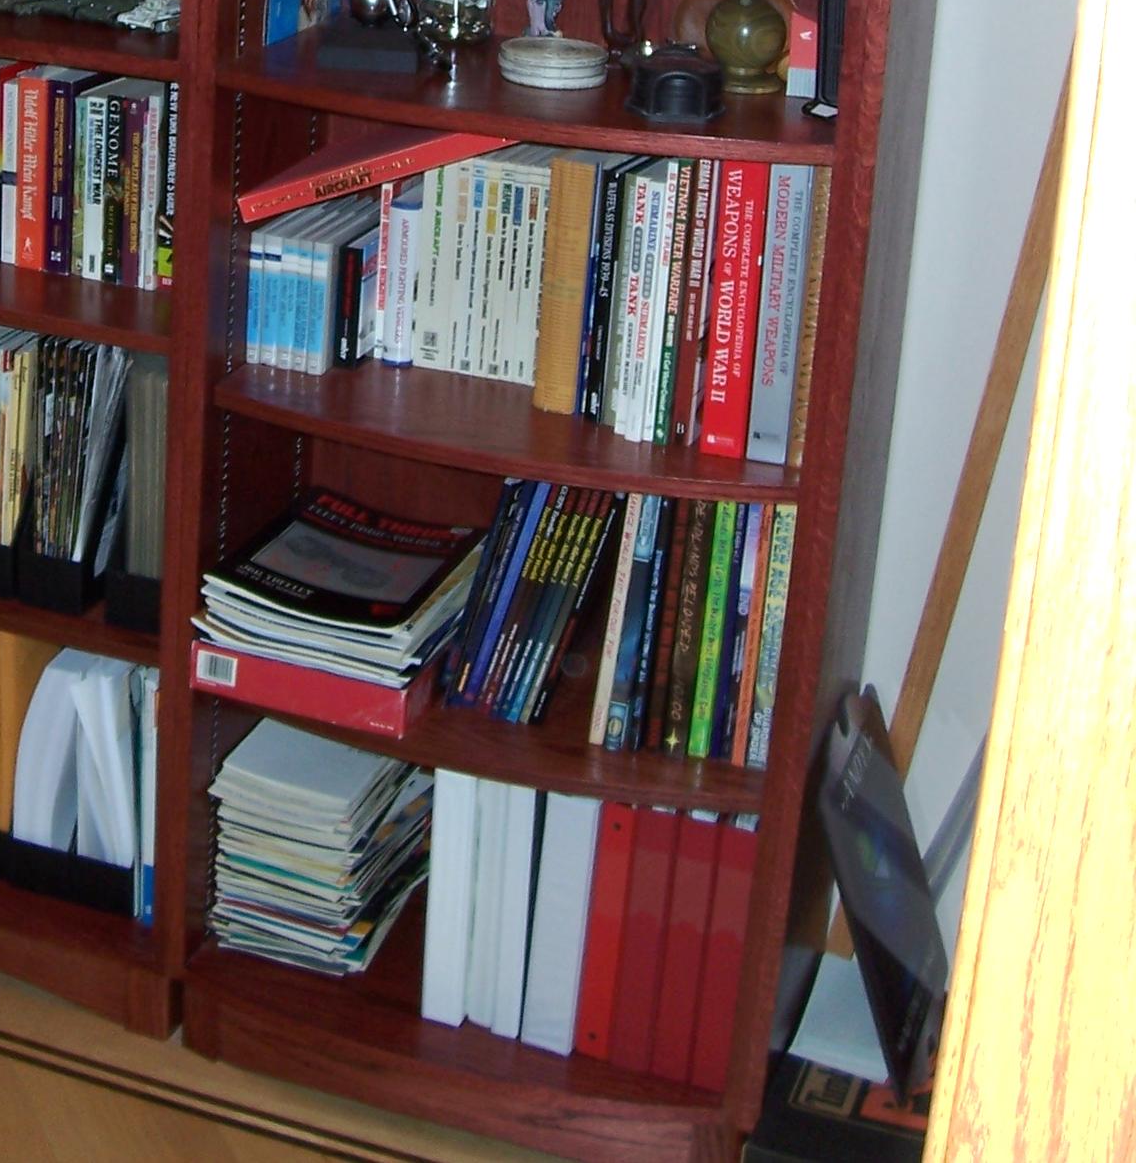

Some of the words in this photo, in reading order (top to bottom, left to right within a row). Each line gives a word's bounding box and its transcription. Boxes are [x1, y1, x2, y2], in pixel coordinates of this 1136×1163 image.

[95, 118, 103, 135] THE
[107, 100, 121, 177] GENOME
[93, 137, 102, 181] LONGEST
[92, 182, 101, 205] WAR
[314, 172, 373, 199] AIRCRAFT
[634, 183, 647, 225] TANK
[664, 172, 677, 230] SOVIET
[676, 165, 692, 220] VIETNAM
[695, 191, 709, 219] TANKS
[775, 175, 791, 240] MODERN
[793, 190, 804, 212] THE
[646, 190, 660, 252] SUBMARINE
[723, 168, 743, 258] WEAPONS
[744, 199, 754, 221] THE
[433, 210, 442, 257] AIRCRAFT
[672, 222, 686, 258] RIVER
[691, 228, 705, 257] WORLD
[739, 223, 753, 278] COMPLETE
[788, 216, 802, 276] COMPLETE
[667, 260, 682, 314] WARFARE
[689, 258, 703, 279] WAR
[723, 262, 733, 277] OF
[767, 243, 786, 313] MILITARY
[627, 275, 641, 316] TANK
[715, 280, 735, 344] WORLD
[636, 301, 651, 359] SUBMARINE
[733, 280, 748, 359] ENCYCLOPEDIA
[780, 278, 797, 358] ENCYCLOPEDIA
[711, 347, 730, 387] WAR
[732, 362, 742, 377] OF
[761, 315, 780, 387] WEAPONS
[779, 360, 789, 376] OF
[710, 389, 725, 404] II
